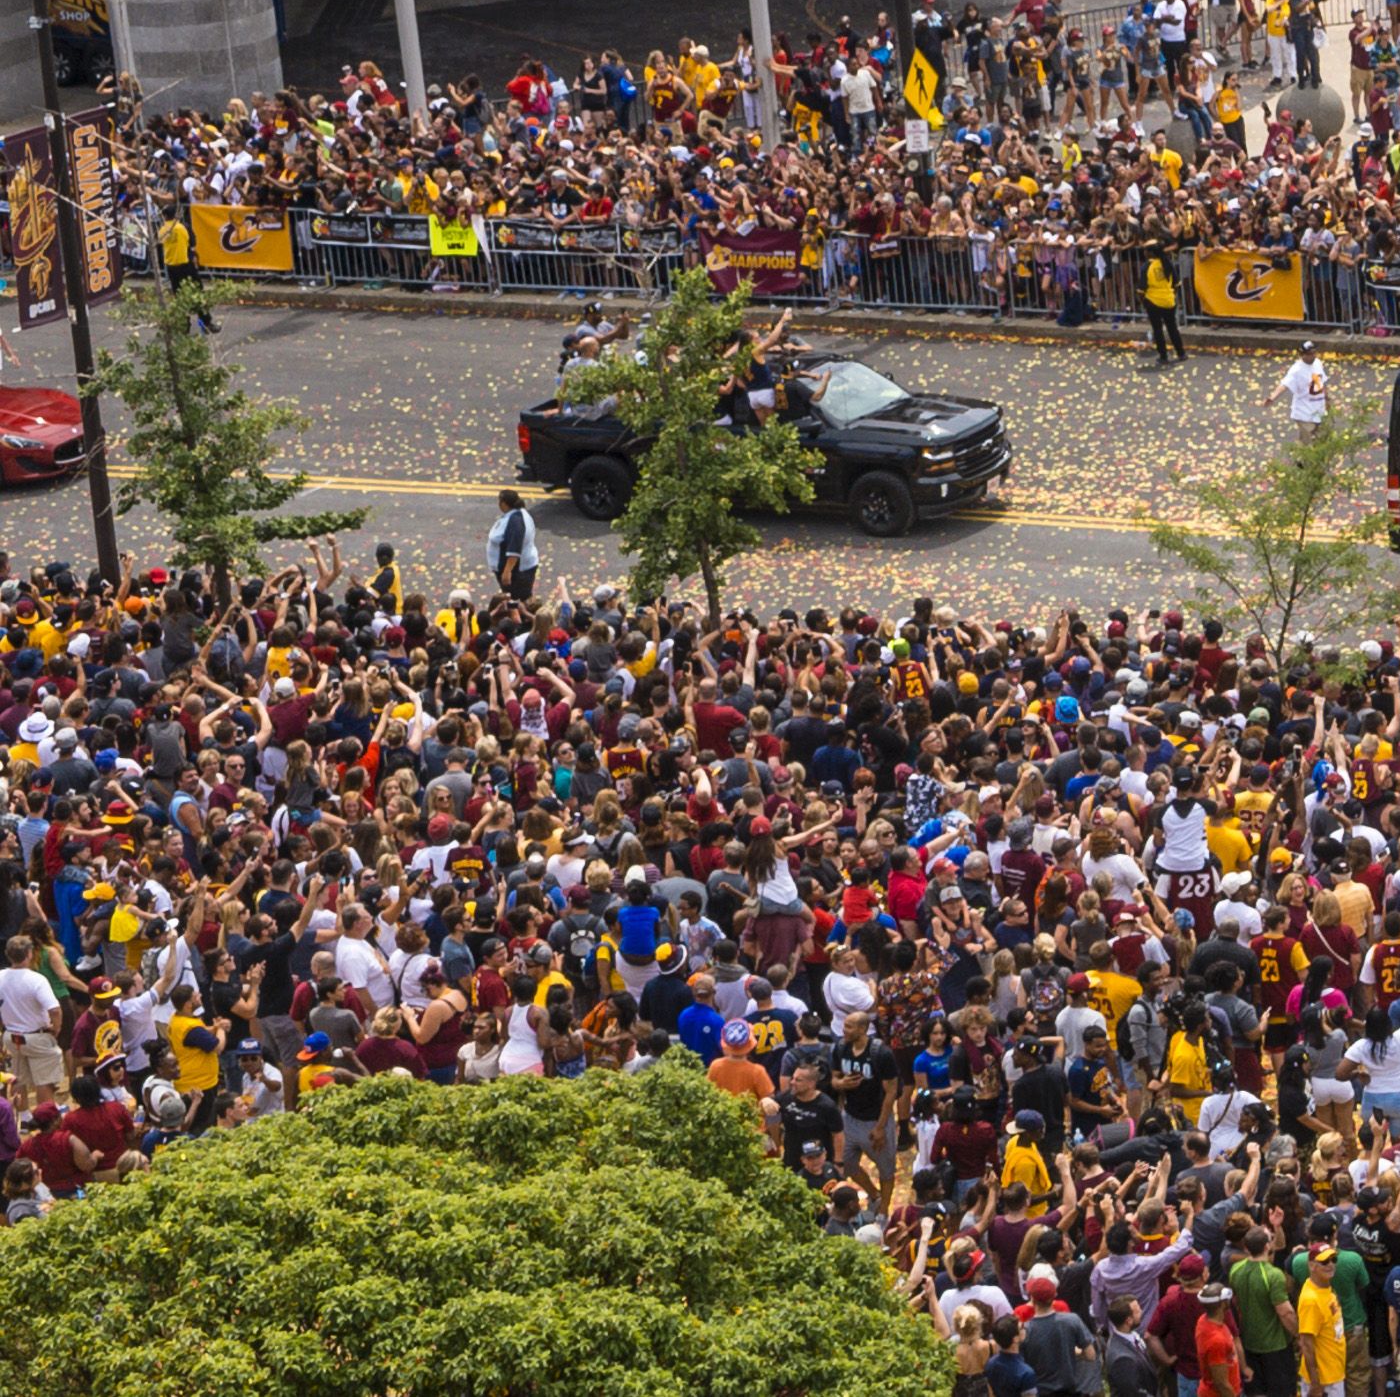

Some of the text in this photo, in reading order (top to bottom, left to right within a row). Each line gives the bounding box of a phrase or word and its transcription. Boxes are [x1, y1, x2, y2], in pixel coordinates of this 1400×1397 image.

[59, 10, 91, 23] SHOP
[72, 123, 113, 294] CAVALIERS
[706, 244, 796, 272] CHAMPIONS
[1177, 872, 1211, 899] 23
[1259, 959, 1281, 983] 23
[753, 1020, 785, 1055] 23
